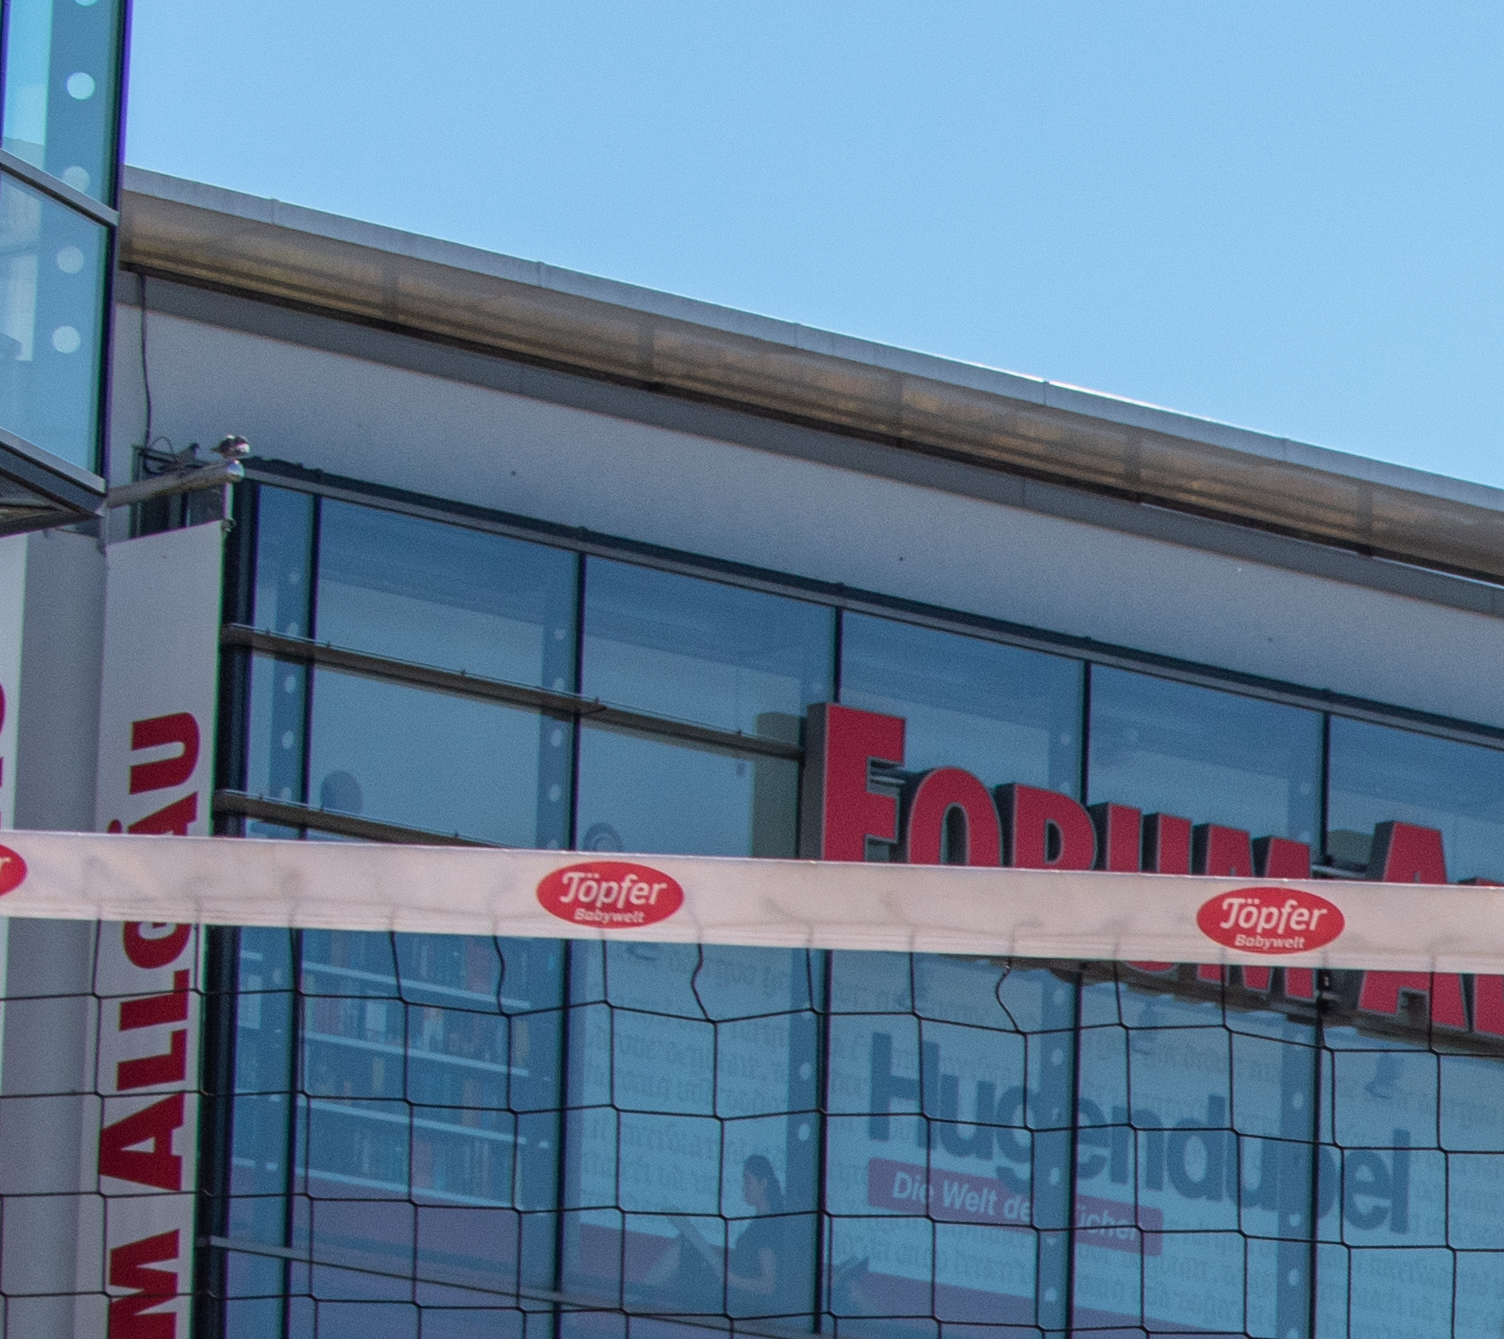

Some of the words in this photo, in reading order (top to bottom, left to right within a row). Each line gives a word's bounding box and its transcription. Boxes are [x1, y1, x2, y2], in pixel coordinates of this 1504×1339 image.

[559, 871, 668, 909] Töpfer
[574, 908, 645, 925] Babywelt
[1220, 897, 1328, 934] Töpfer
[1234, 934, 1305, 950] Babywelt
[892, 1171, 935, 1204] Die
[942, 1178, 996, 1214] Welt
[1001, 1194, 1034, 1223] de
